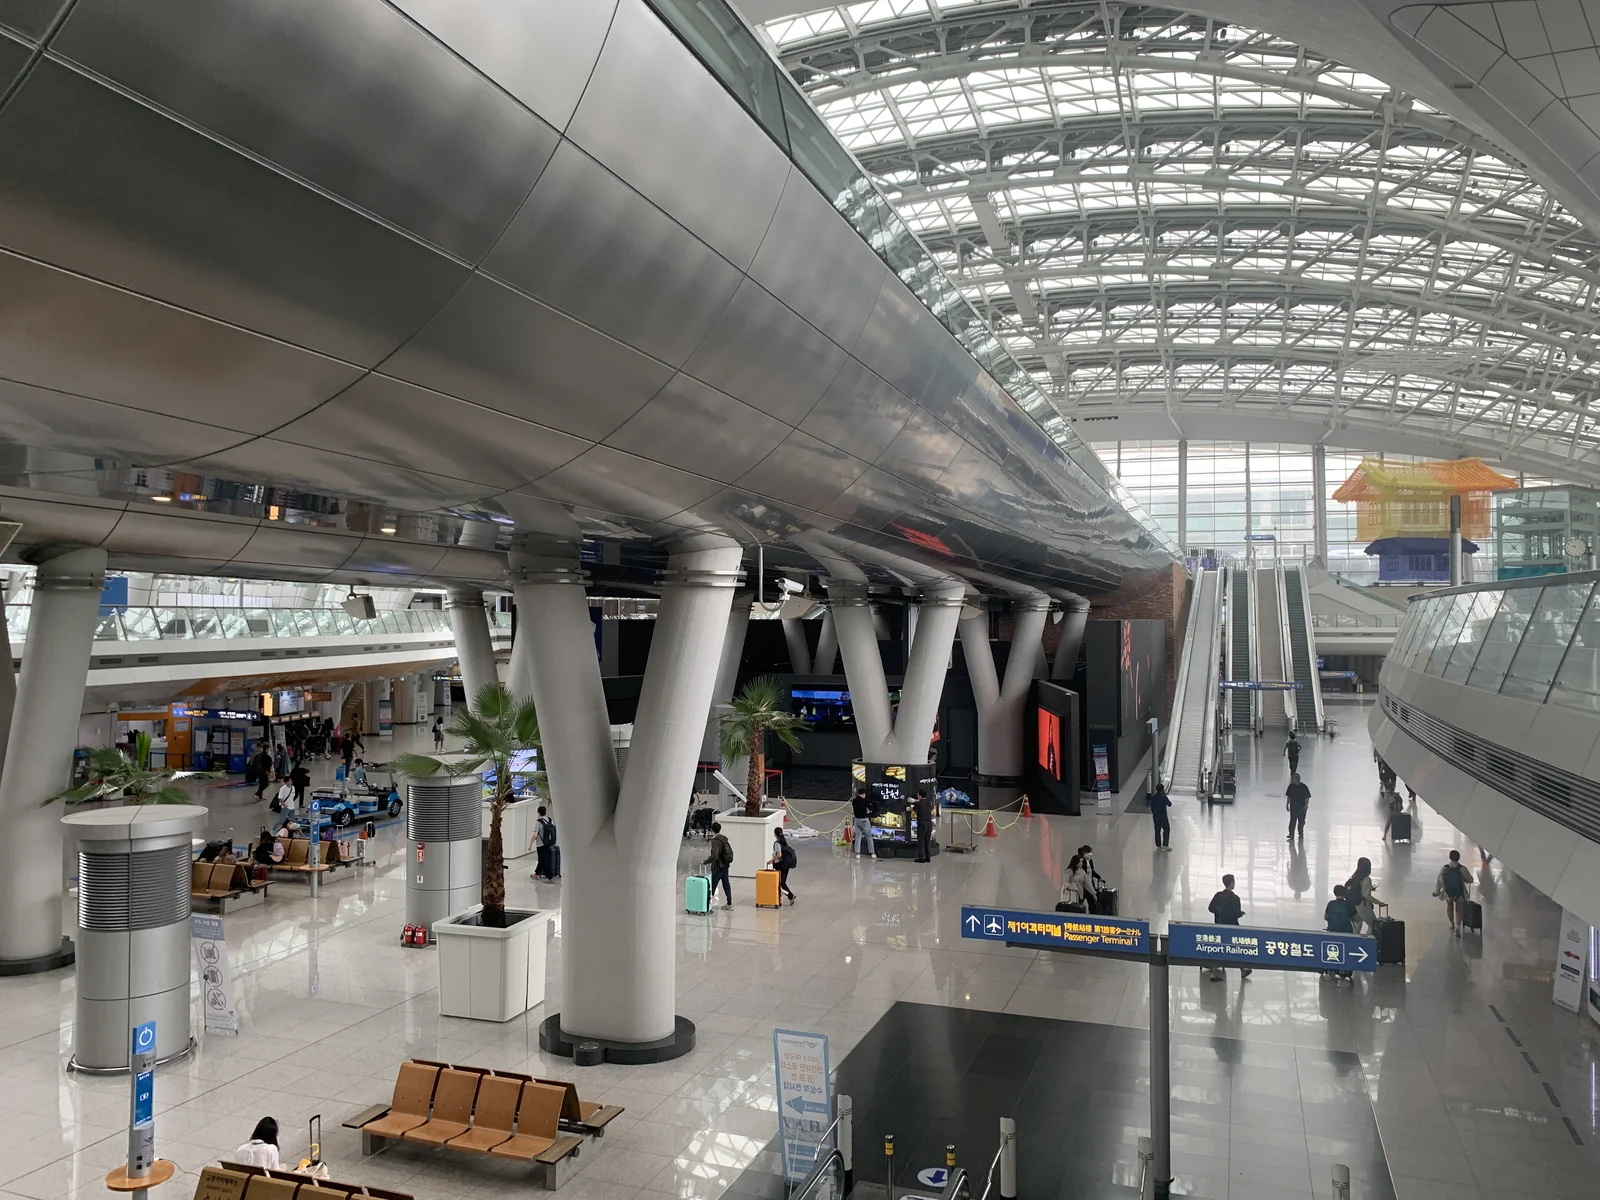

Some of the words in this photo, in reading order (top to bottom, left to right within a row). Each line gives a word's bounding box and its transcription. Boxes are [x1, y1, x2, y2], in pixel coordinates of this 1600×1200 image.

[881, 788, 899, 800] 남원
[1008, 920, 1062, 937] 제1여객터미널
[1064, 932, 1099, 944] Passenger
[1102, 935, 1133, 946] Terminal
[1134, 938, 1139, 946] 1
[1195, 944, 1224, 954] Airport
[1226, 945, 1259, 956] Railroad
[1265, 940, 1315, 958] 공항철도
